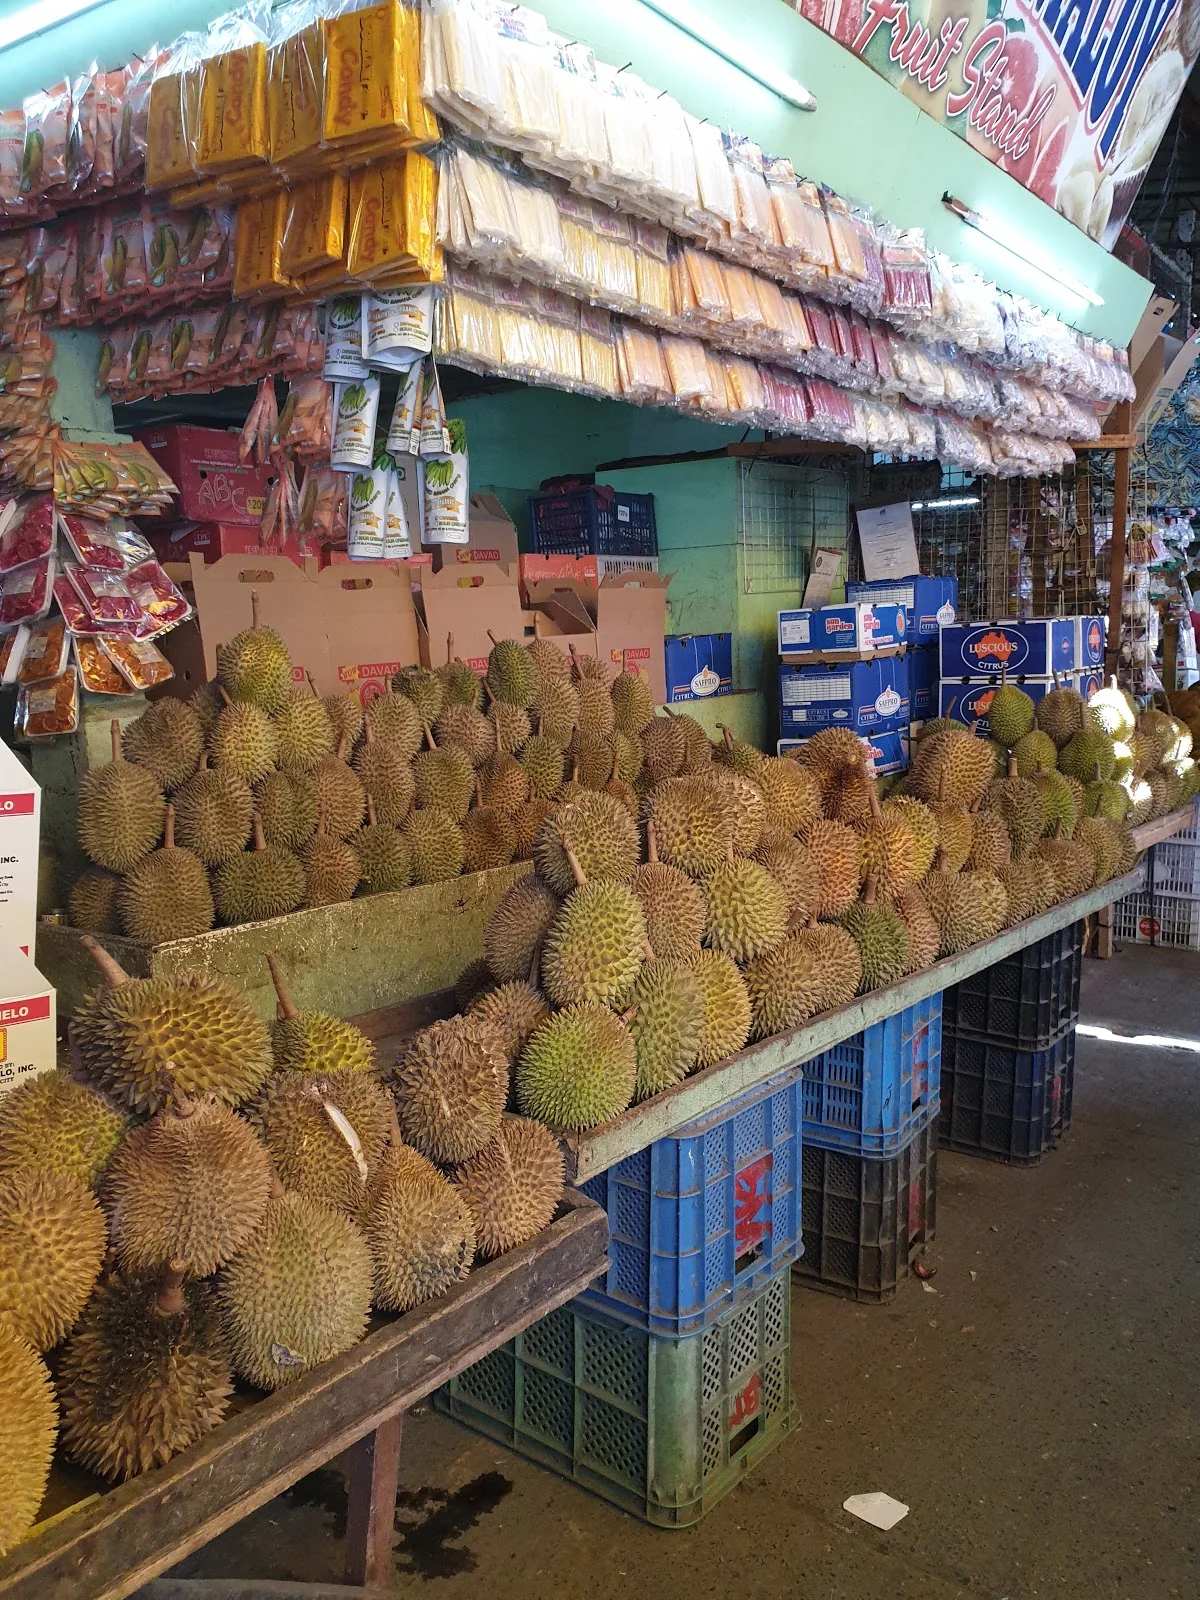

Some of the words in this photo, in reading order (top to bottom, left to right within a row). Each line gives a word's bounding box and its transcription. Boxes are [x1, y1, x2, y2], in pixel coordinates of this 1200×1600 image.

[945, 19, 1056, 161] Stand
[473, 549, 500, 561] DAVAO
[826, 623, 854, 633] garden
[969, 641, 1018, 654] LUSCIOUS
[361, 664, 399, 677] DAVAO
[977, 660, 1009, 670] CITRUS
[18, 1064, 37, 1074] INC.
